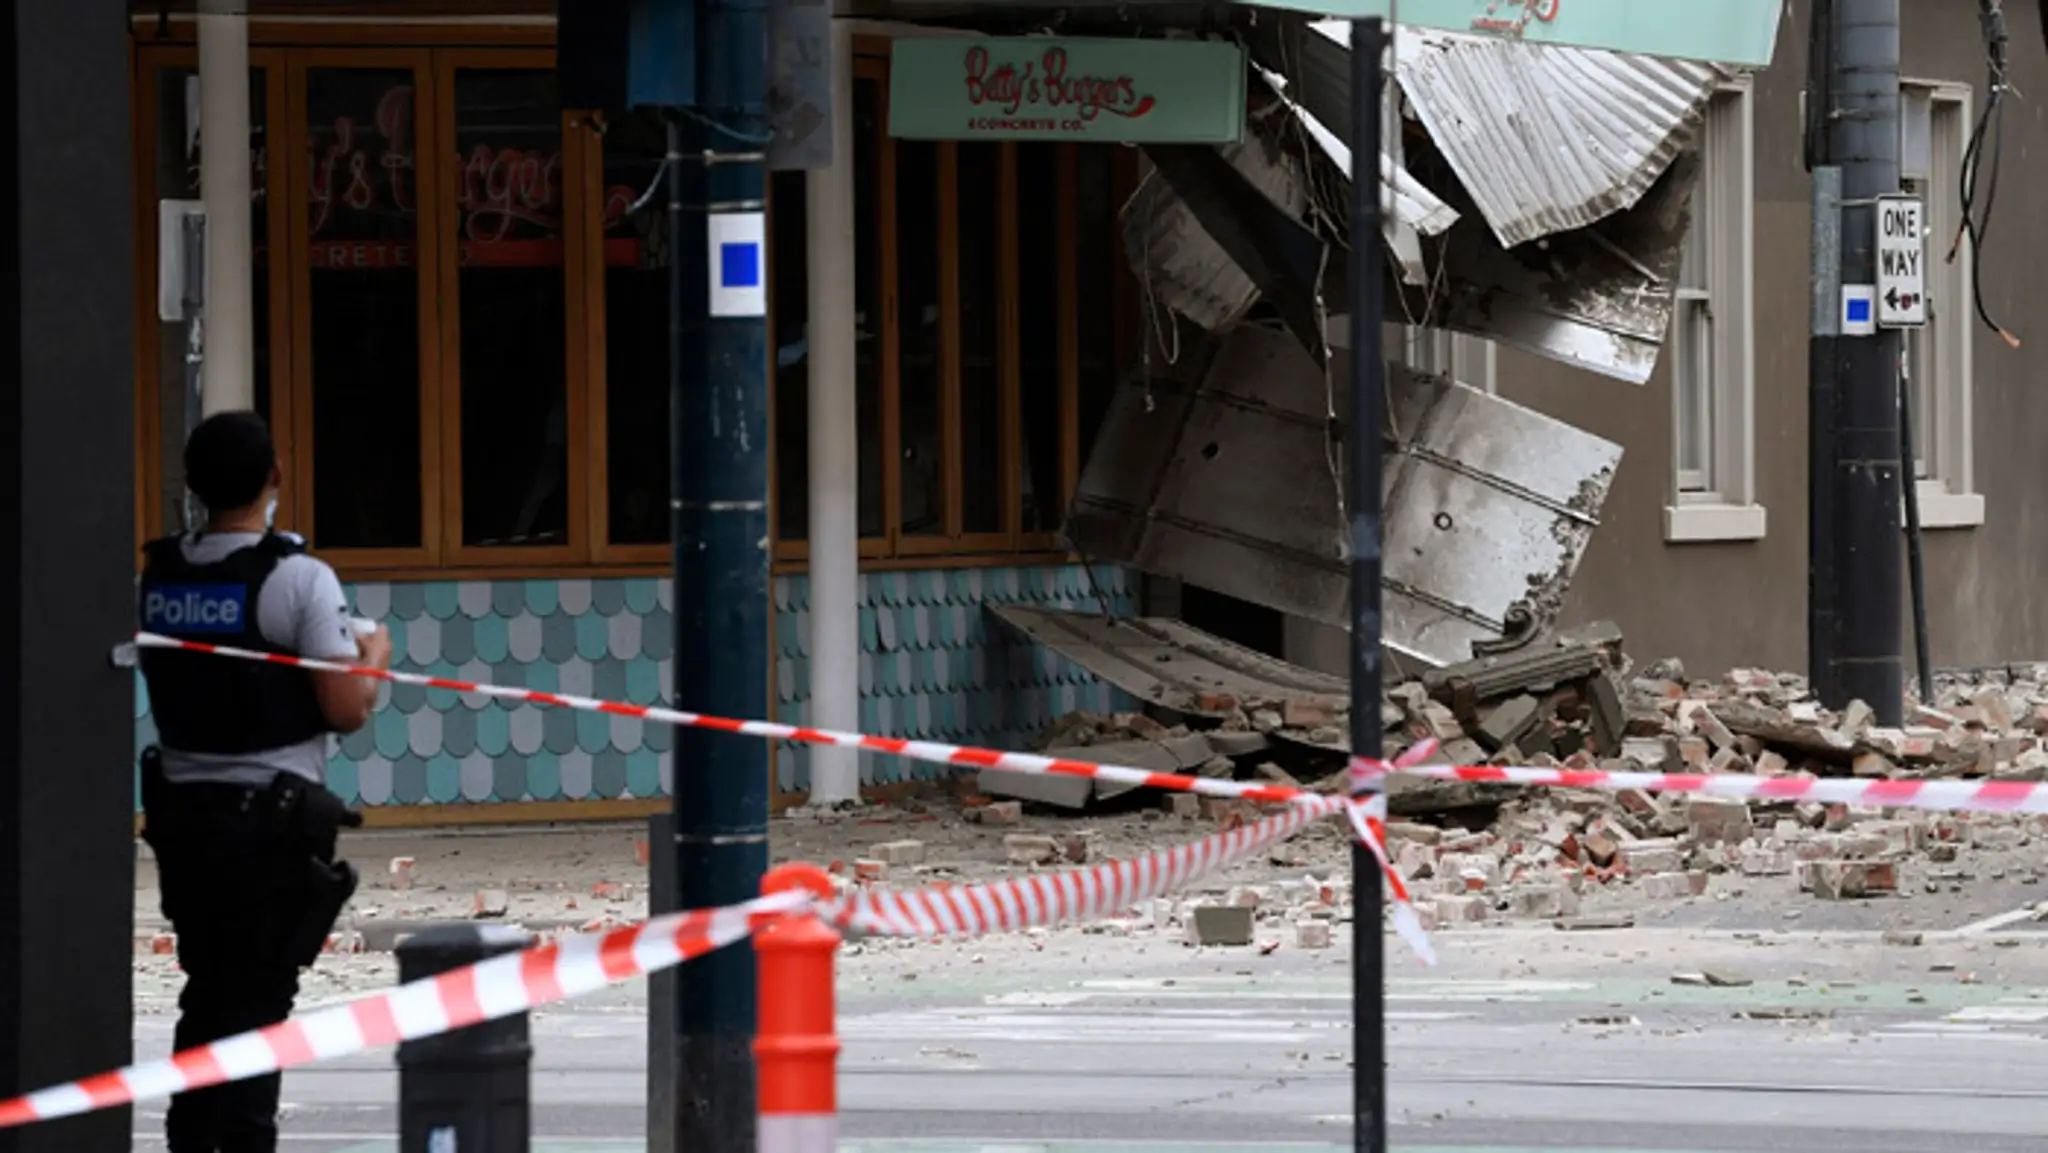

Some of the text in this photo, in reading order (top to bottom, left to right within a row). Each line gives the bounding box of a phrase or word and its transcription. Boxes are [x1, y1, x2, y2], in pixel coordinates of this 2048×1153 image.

[964, 45, 1156, 121] Betty's Burgers
[1884, 209, 1917, 238] ONE
[1882, 249, 1918, 277] WAY
[146, 591, 240, 625] Police
